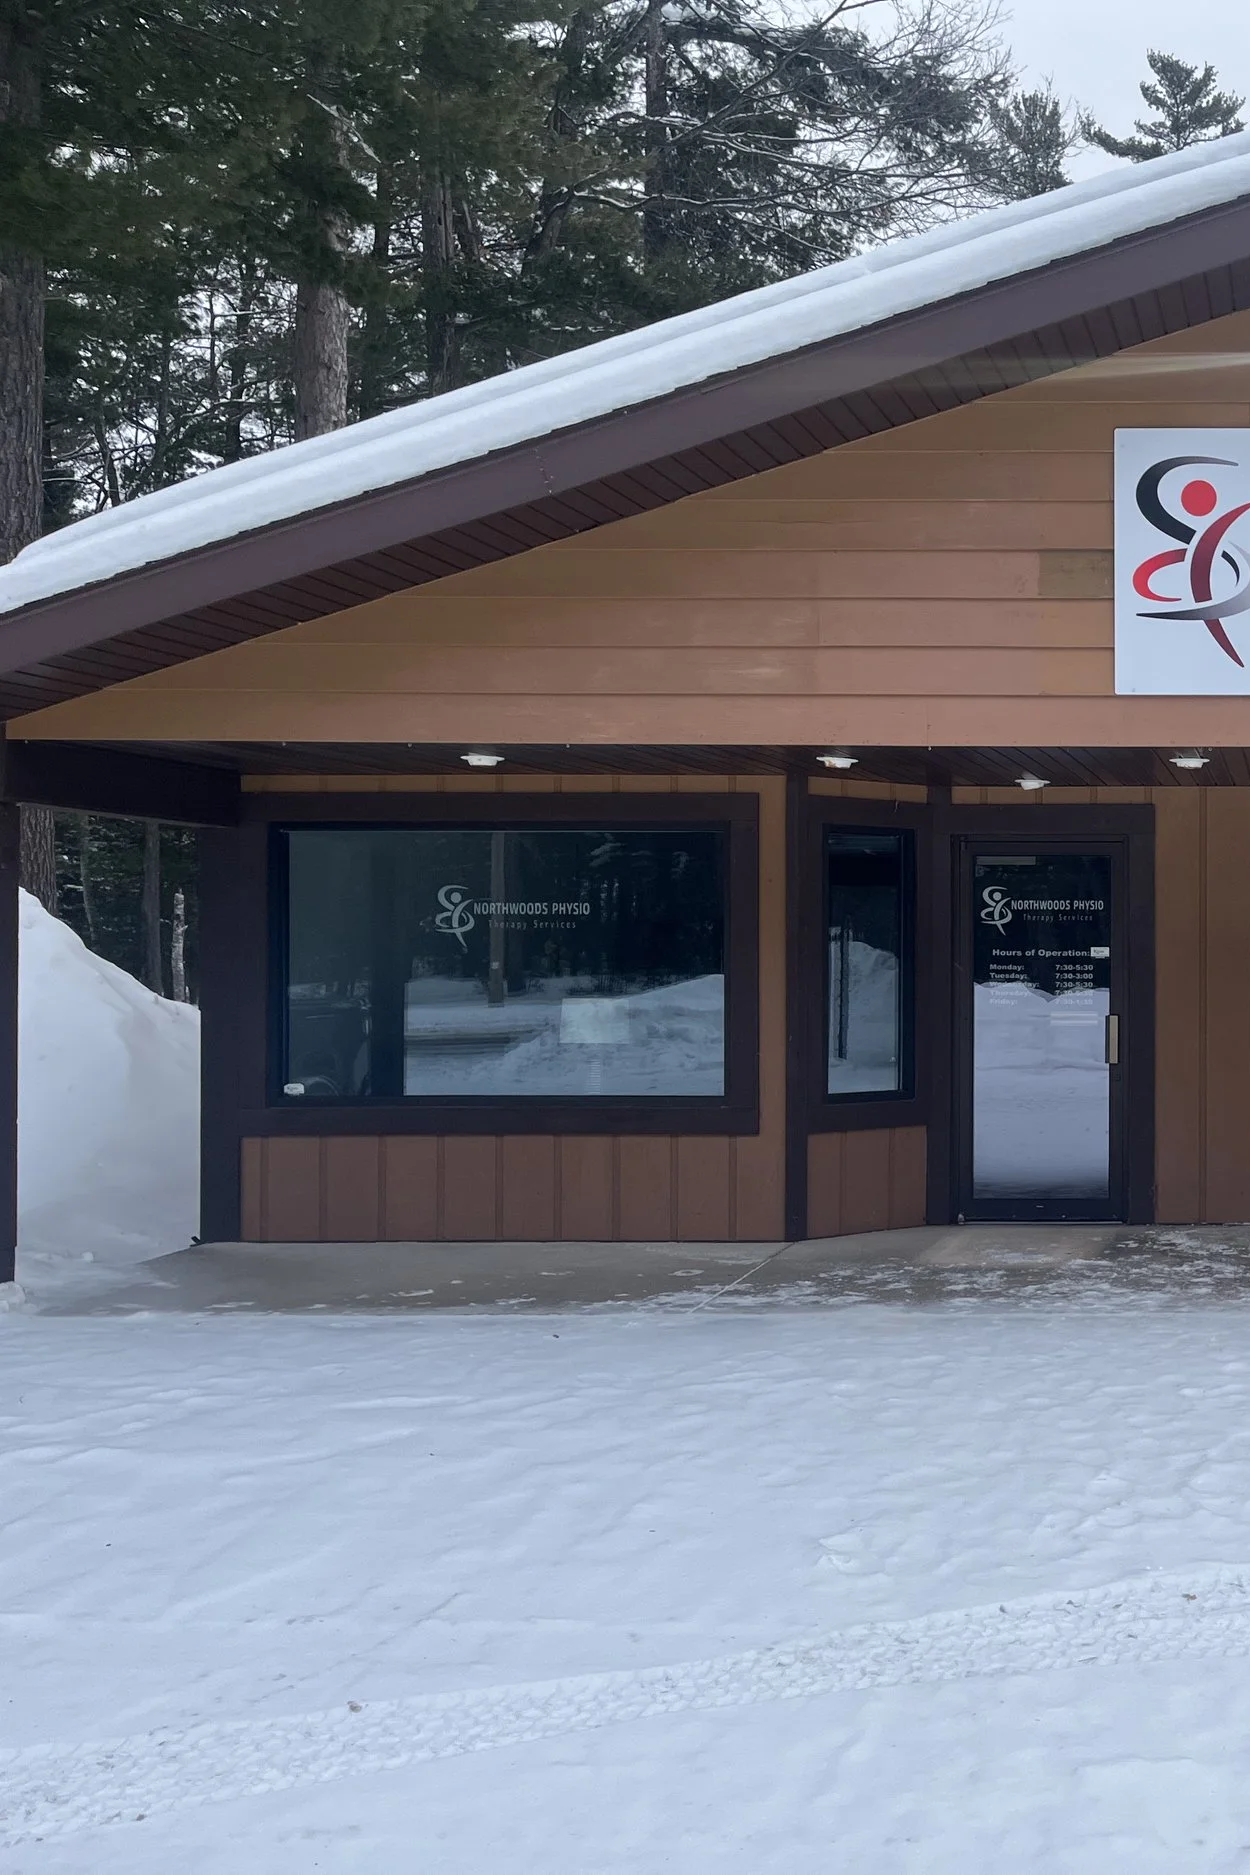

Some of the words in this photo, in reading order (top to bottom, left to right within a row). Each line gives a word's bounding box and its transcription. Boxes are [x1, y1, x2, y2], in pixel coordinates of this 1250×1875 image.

[473, 902, 548, 914] NORTHWOODS
[552, 902, 591, 915] PHYSIO
[1011, 900, 1071, 910] NORTHWOODS
[1074, 900, 1104, 910] PHYSIO
[1024, 914, 1054, 922] Therapy
[488, 920, 526, 930] Therapy
[533, 919, 576, 929] Services
[1038, 949, 1090, 958] Operation:
[989, 964, 1024, 972] Monday:
